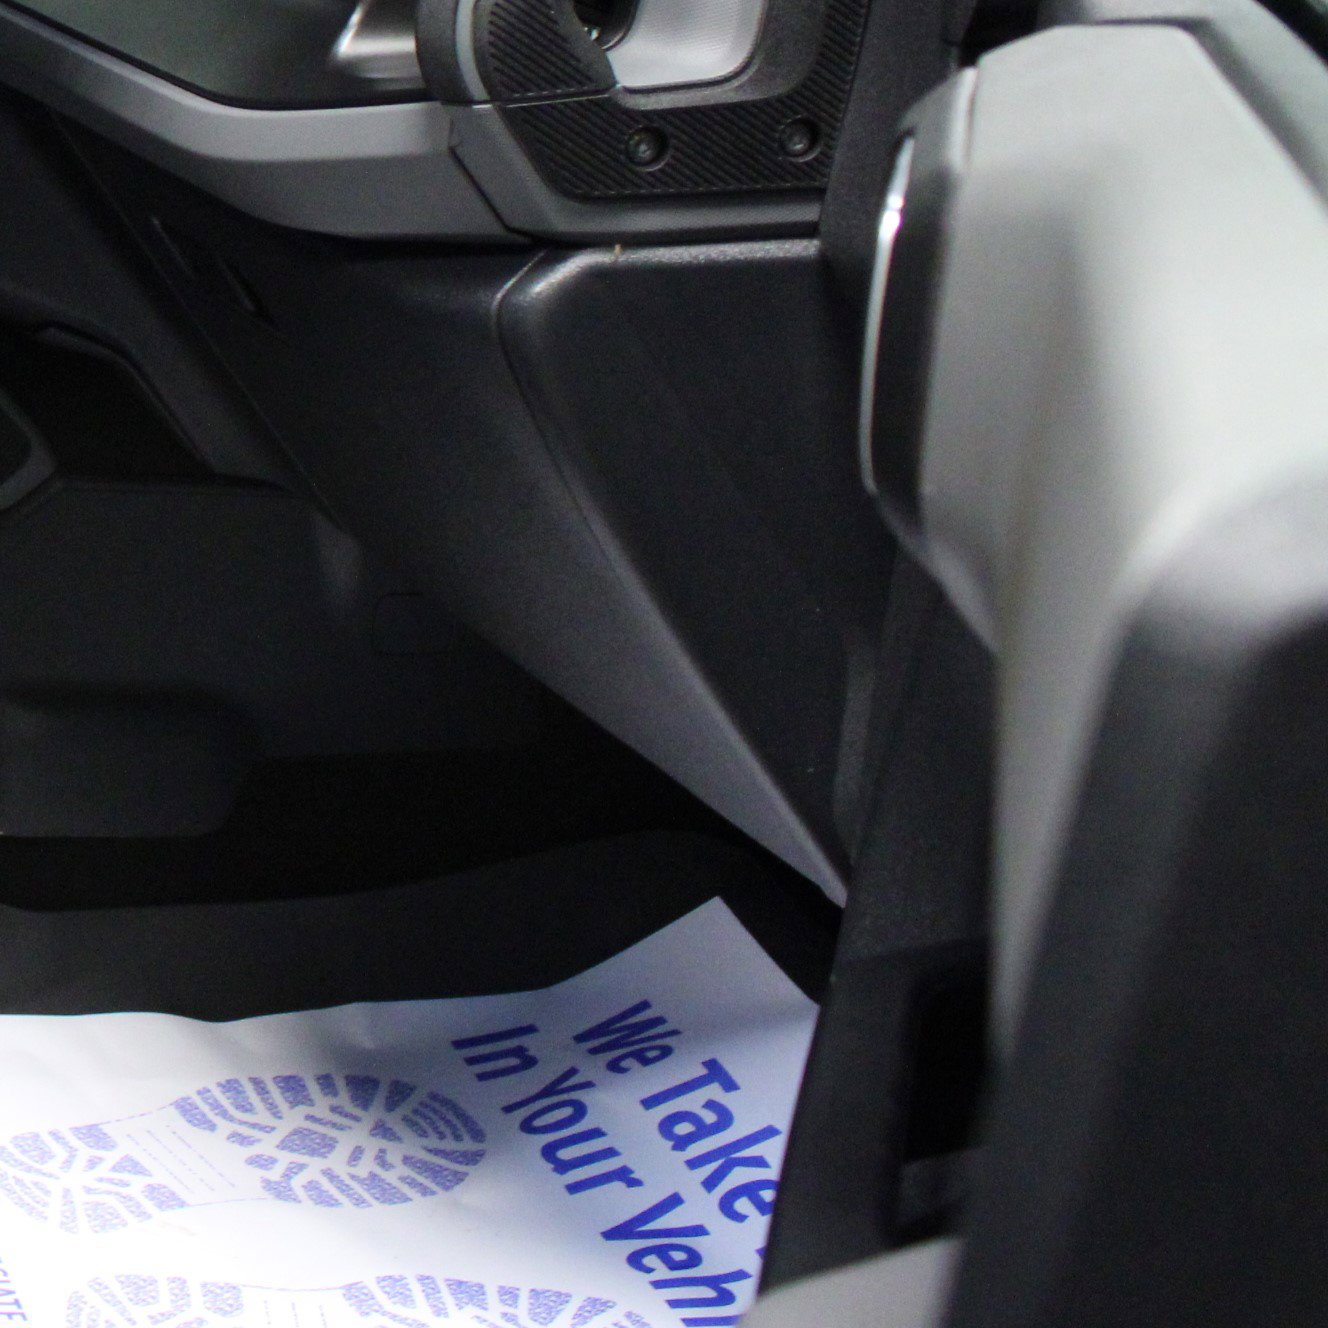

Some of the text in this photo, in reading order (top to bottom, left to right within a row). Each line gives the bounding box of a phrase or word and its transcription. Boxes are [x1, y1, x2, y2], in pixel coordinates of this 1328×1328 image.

[450, 1024, 540, 1082] In
[500, 1066, 645, 1196] Your
[572, 999, 783, 1223] We Take
